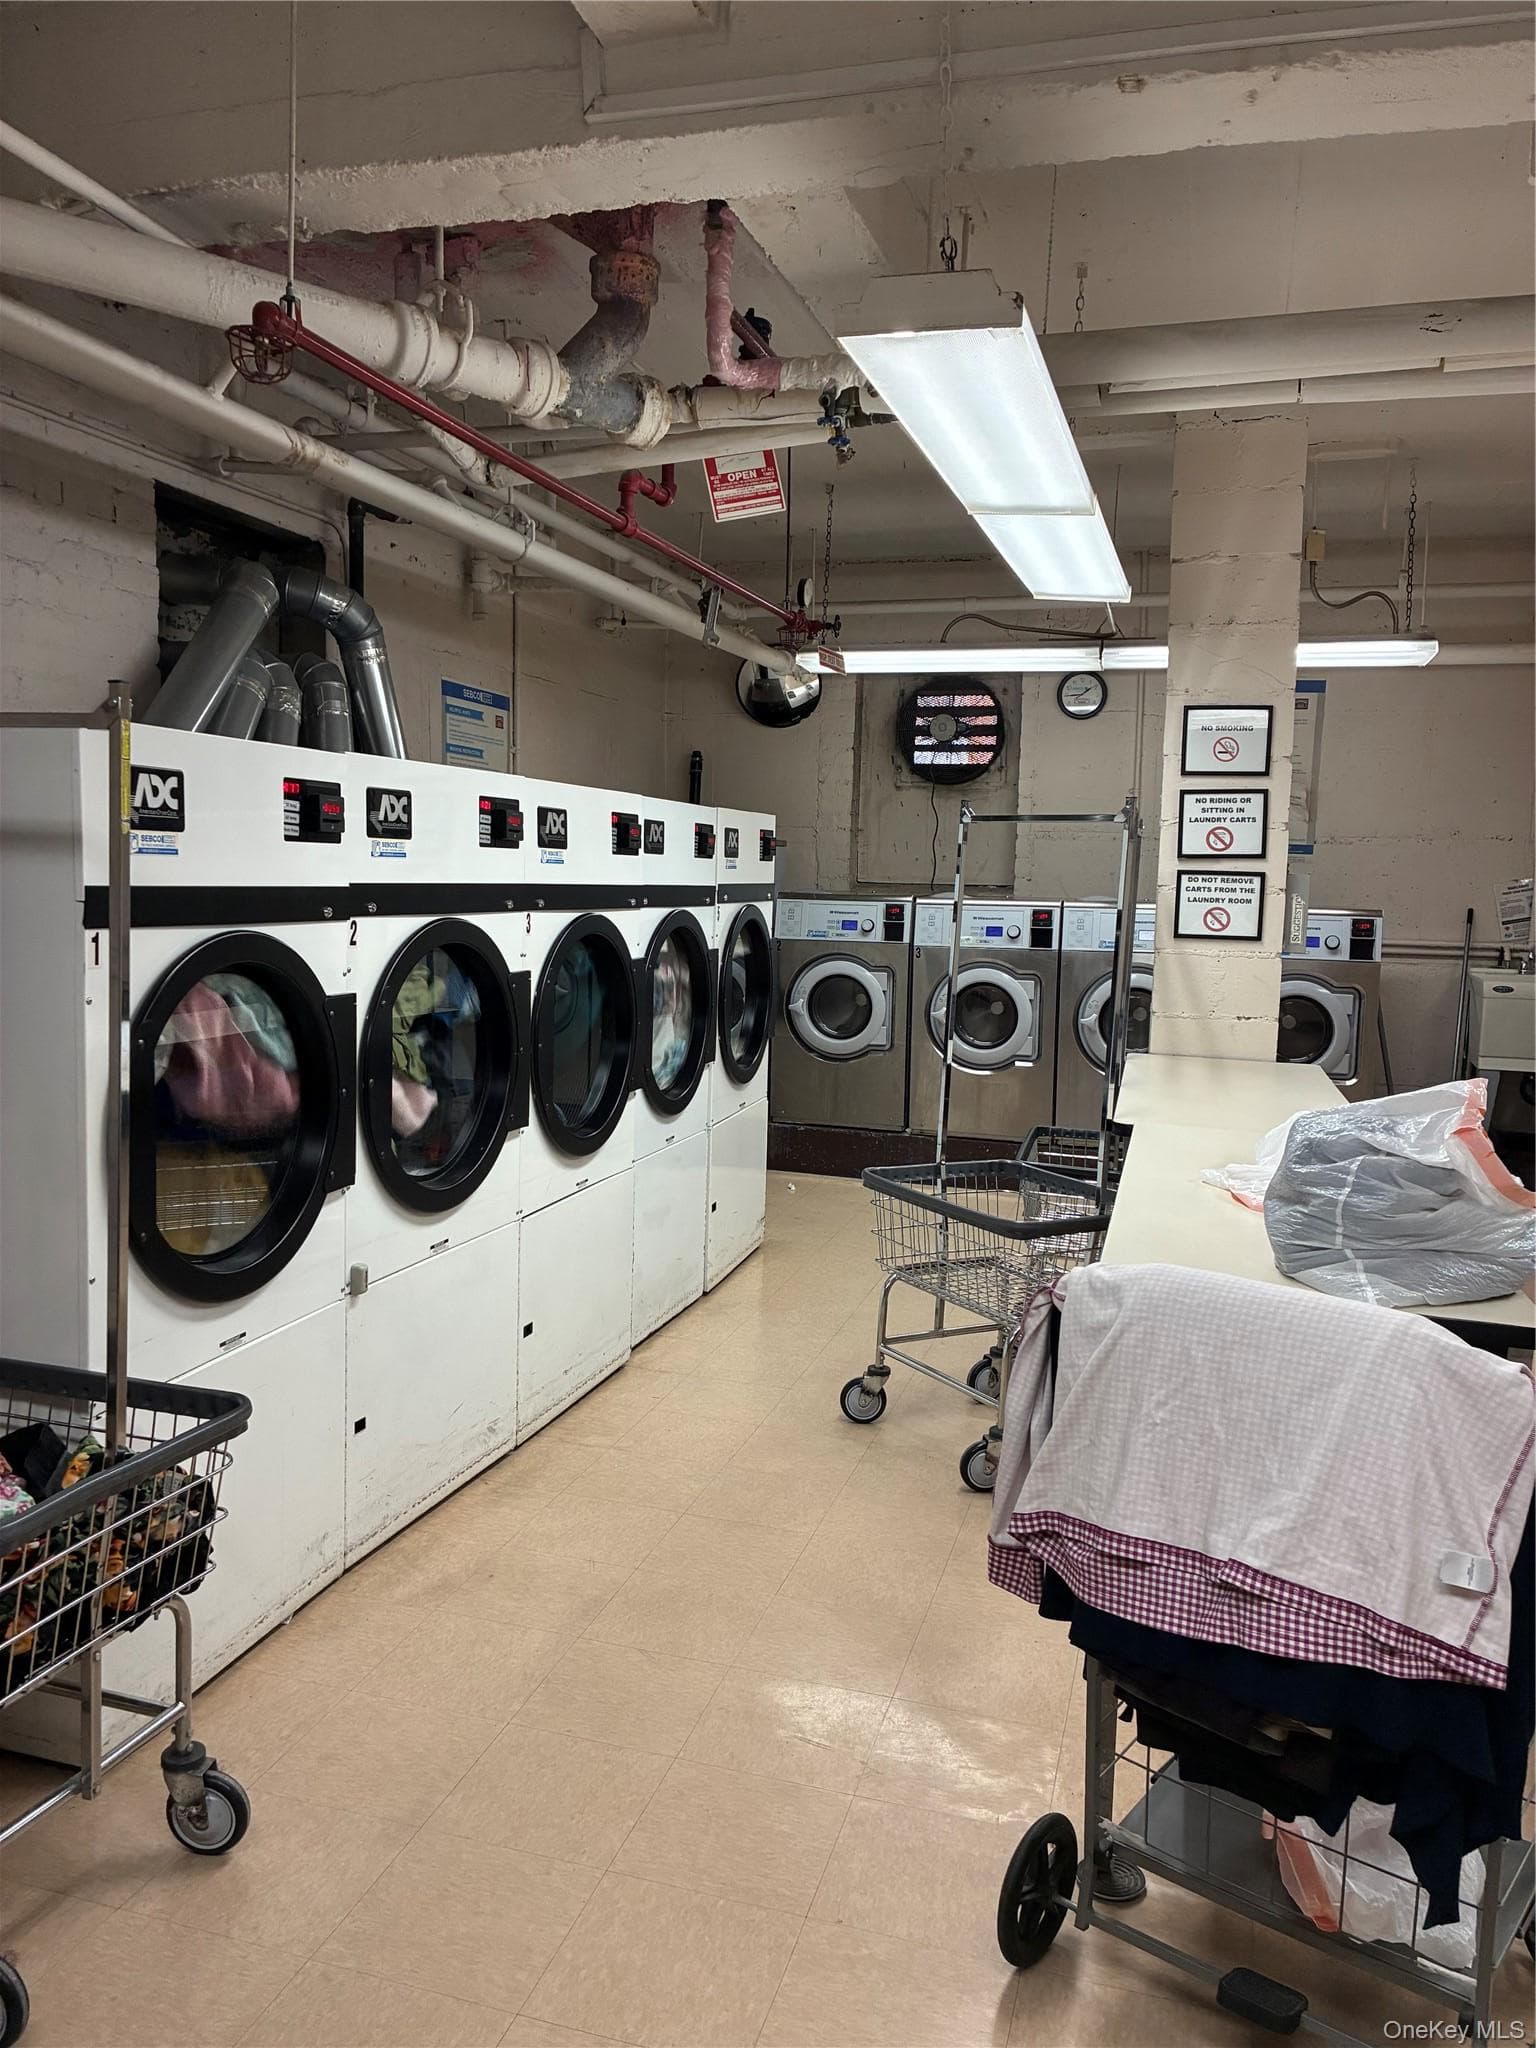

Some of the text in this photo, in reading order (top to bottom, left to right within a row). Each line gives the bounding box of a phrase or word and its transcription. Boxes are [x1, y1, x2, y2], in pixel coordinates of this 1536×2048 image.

[727, 470, 757, 481] OPEN
[463, 688, 481, 701] SEBCO
[134, 773, 179, 810] ADC
[379, 794, 408, 823] ADC
[546, 812, 565, 835] ADC
[141, 834, 161, 843] SEBCO
[350, 919, 358, 946] 2
[526, 912, 531, 935] 3
[91, 931, 100, 966] 1
[776, 940, 782, 951] 2
[915, 946, 921, 958] 3
